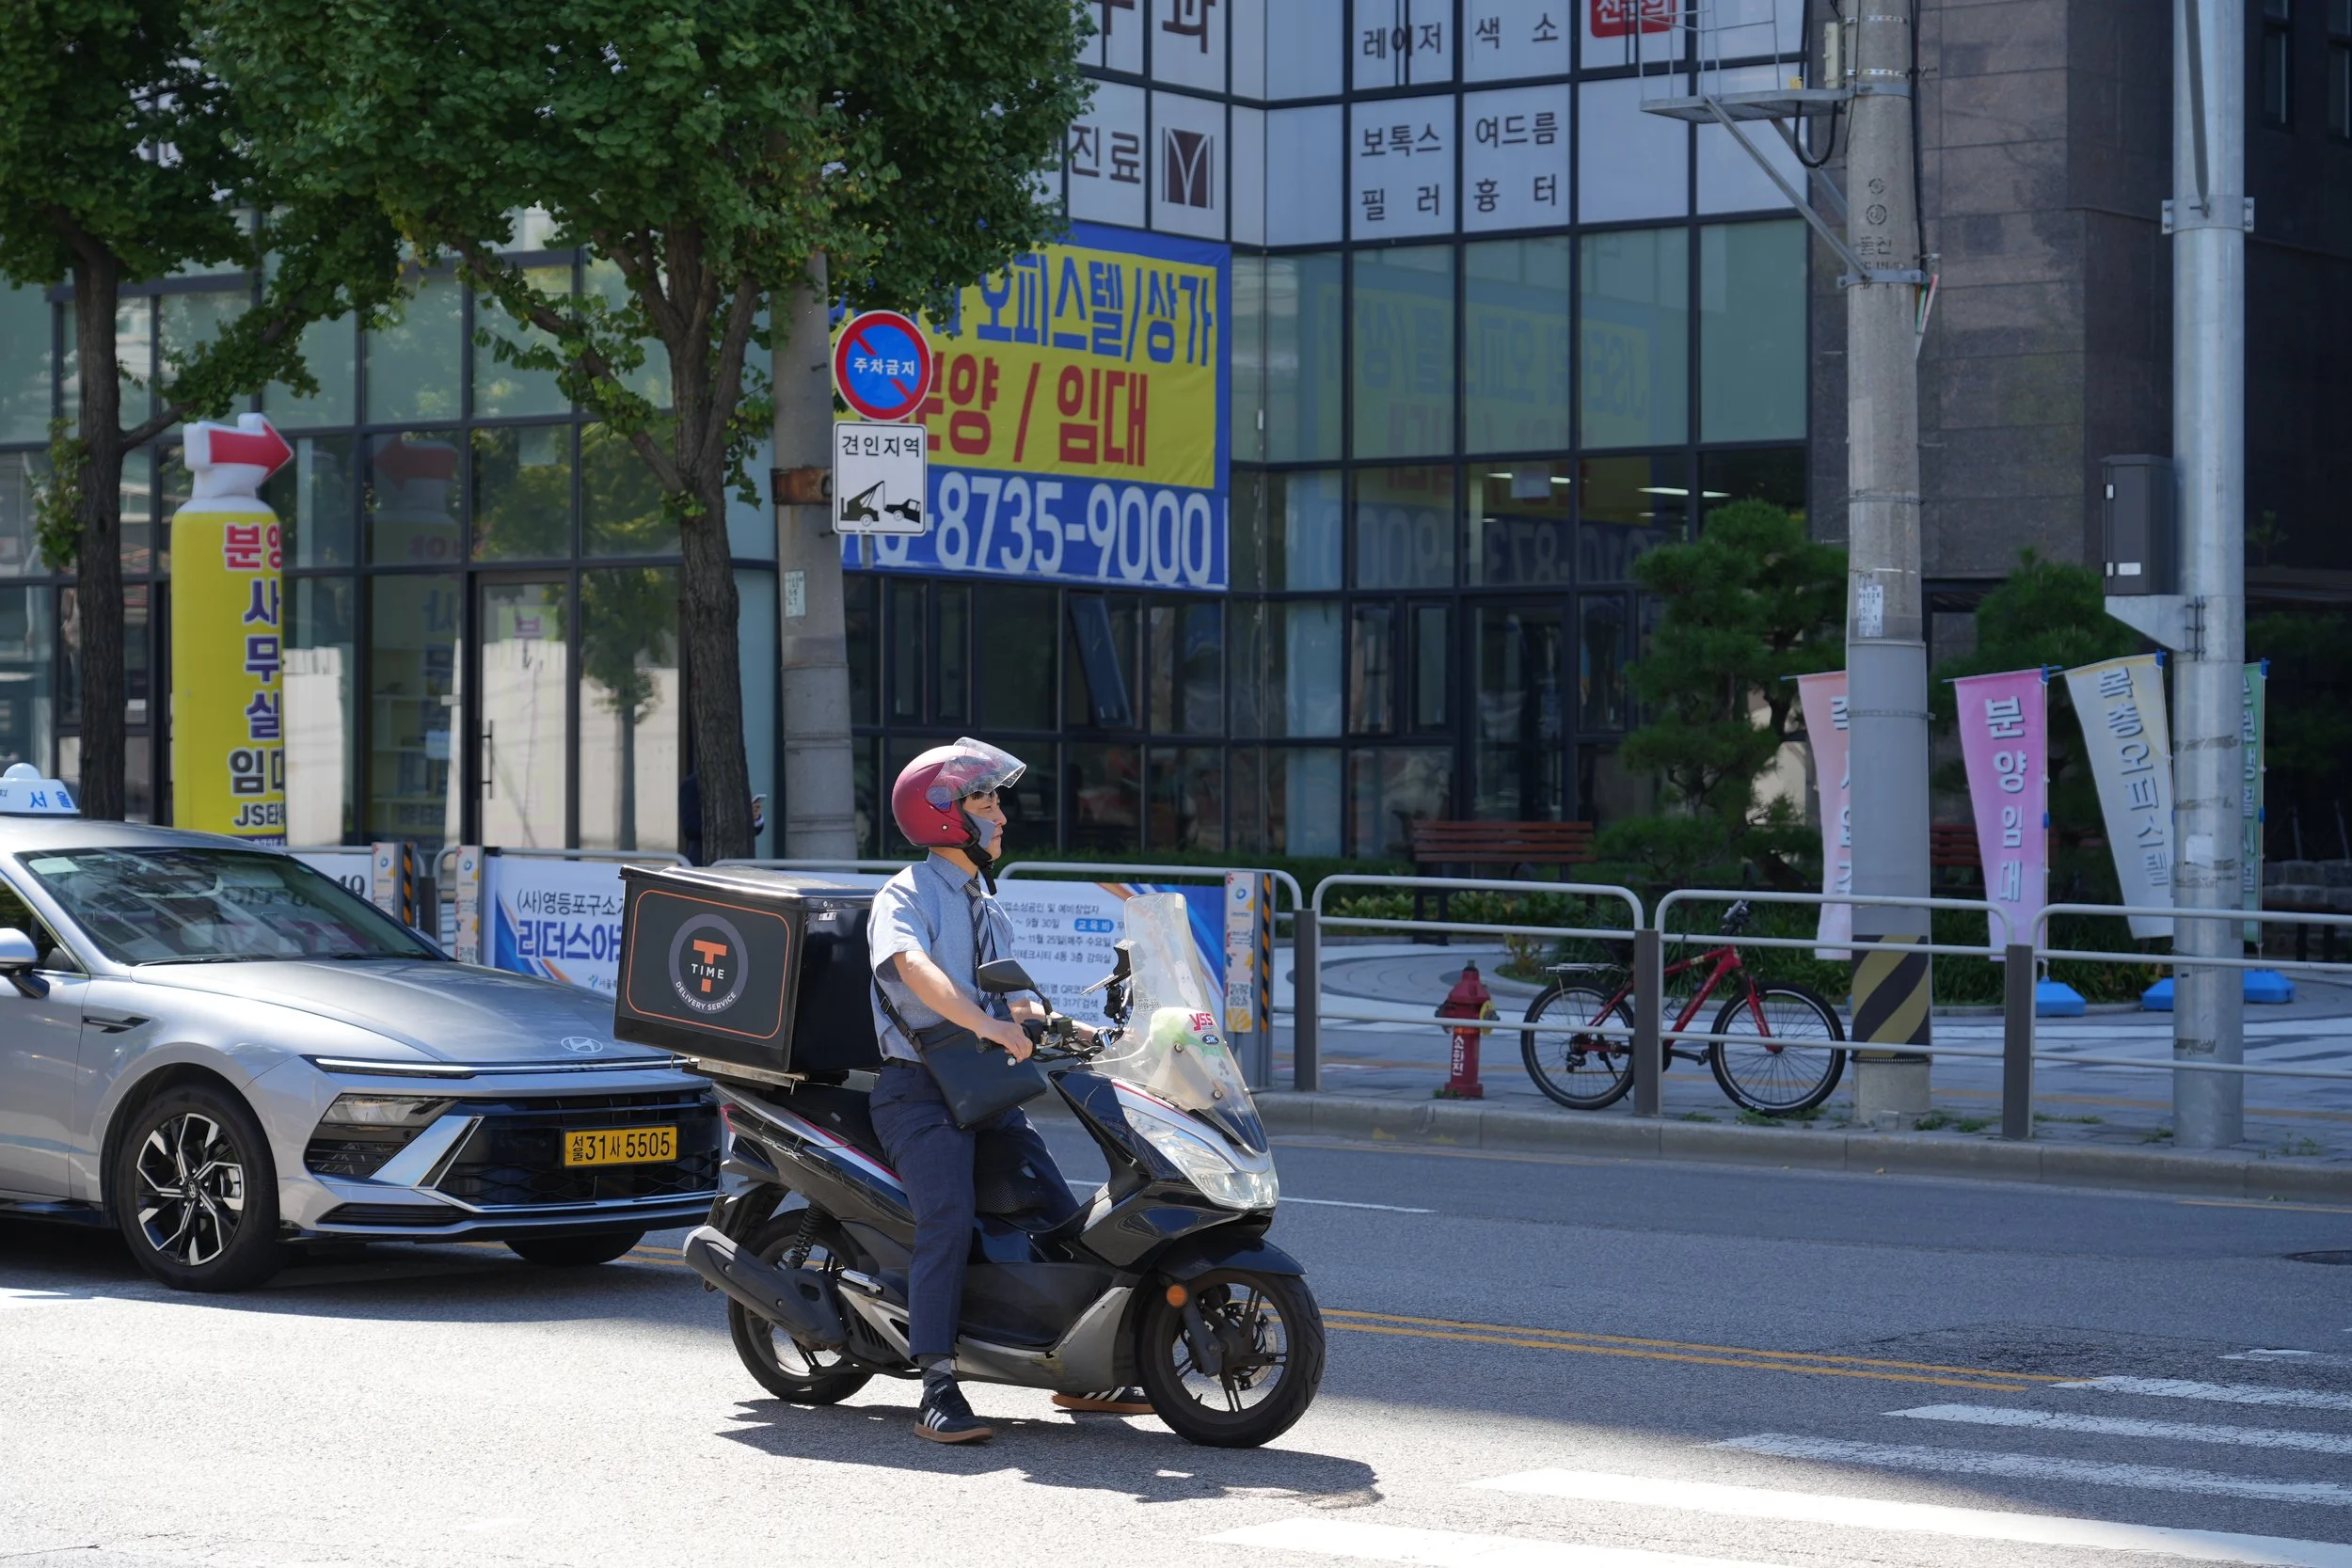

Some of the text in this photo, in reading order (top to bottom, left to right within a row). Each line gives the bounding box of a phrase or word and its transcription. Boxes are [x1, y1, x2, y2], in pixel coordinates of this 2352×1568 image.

[1363, 22, 1441, 60] 레이저
[1360, 112, 1558, 158] 보톡스 여드름
[977, 252, 1212, 367] 오피스텔/상가
[853, 357, 915, 376] 주차금지
[1056, 363, 1149, 467] 임대
[842, 435, 920, 458] 견인지역
[30, 790, 72, 809] 서울
[691, 963, 725, 980] TIME
[675, 981, 737, 1011] DELIVERY SERVICE
[1452, 1035, 1465, 1076] 소화전
[572, 1135, 583, 1162] 서울
[626, 1132, 670, 1158] 5505
